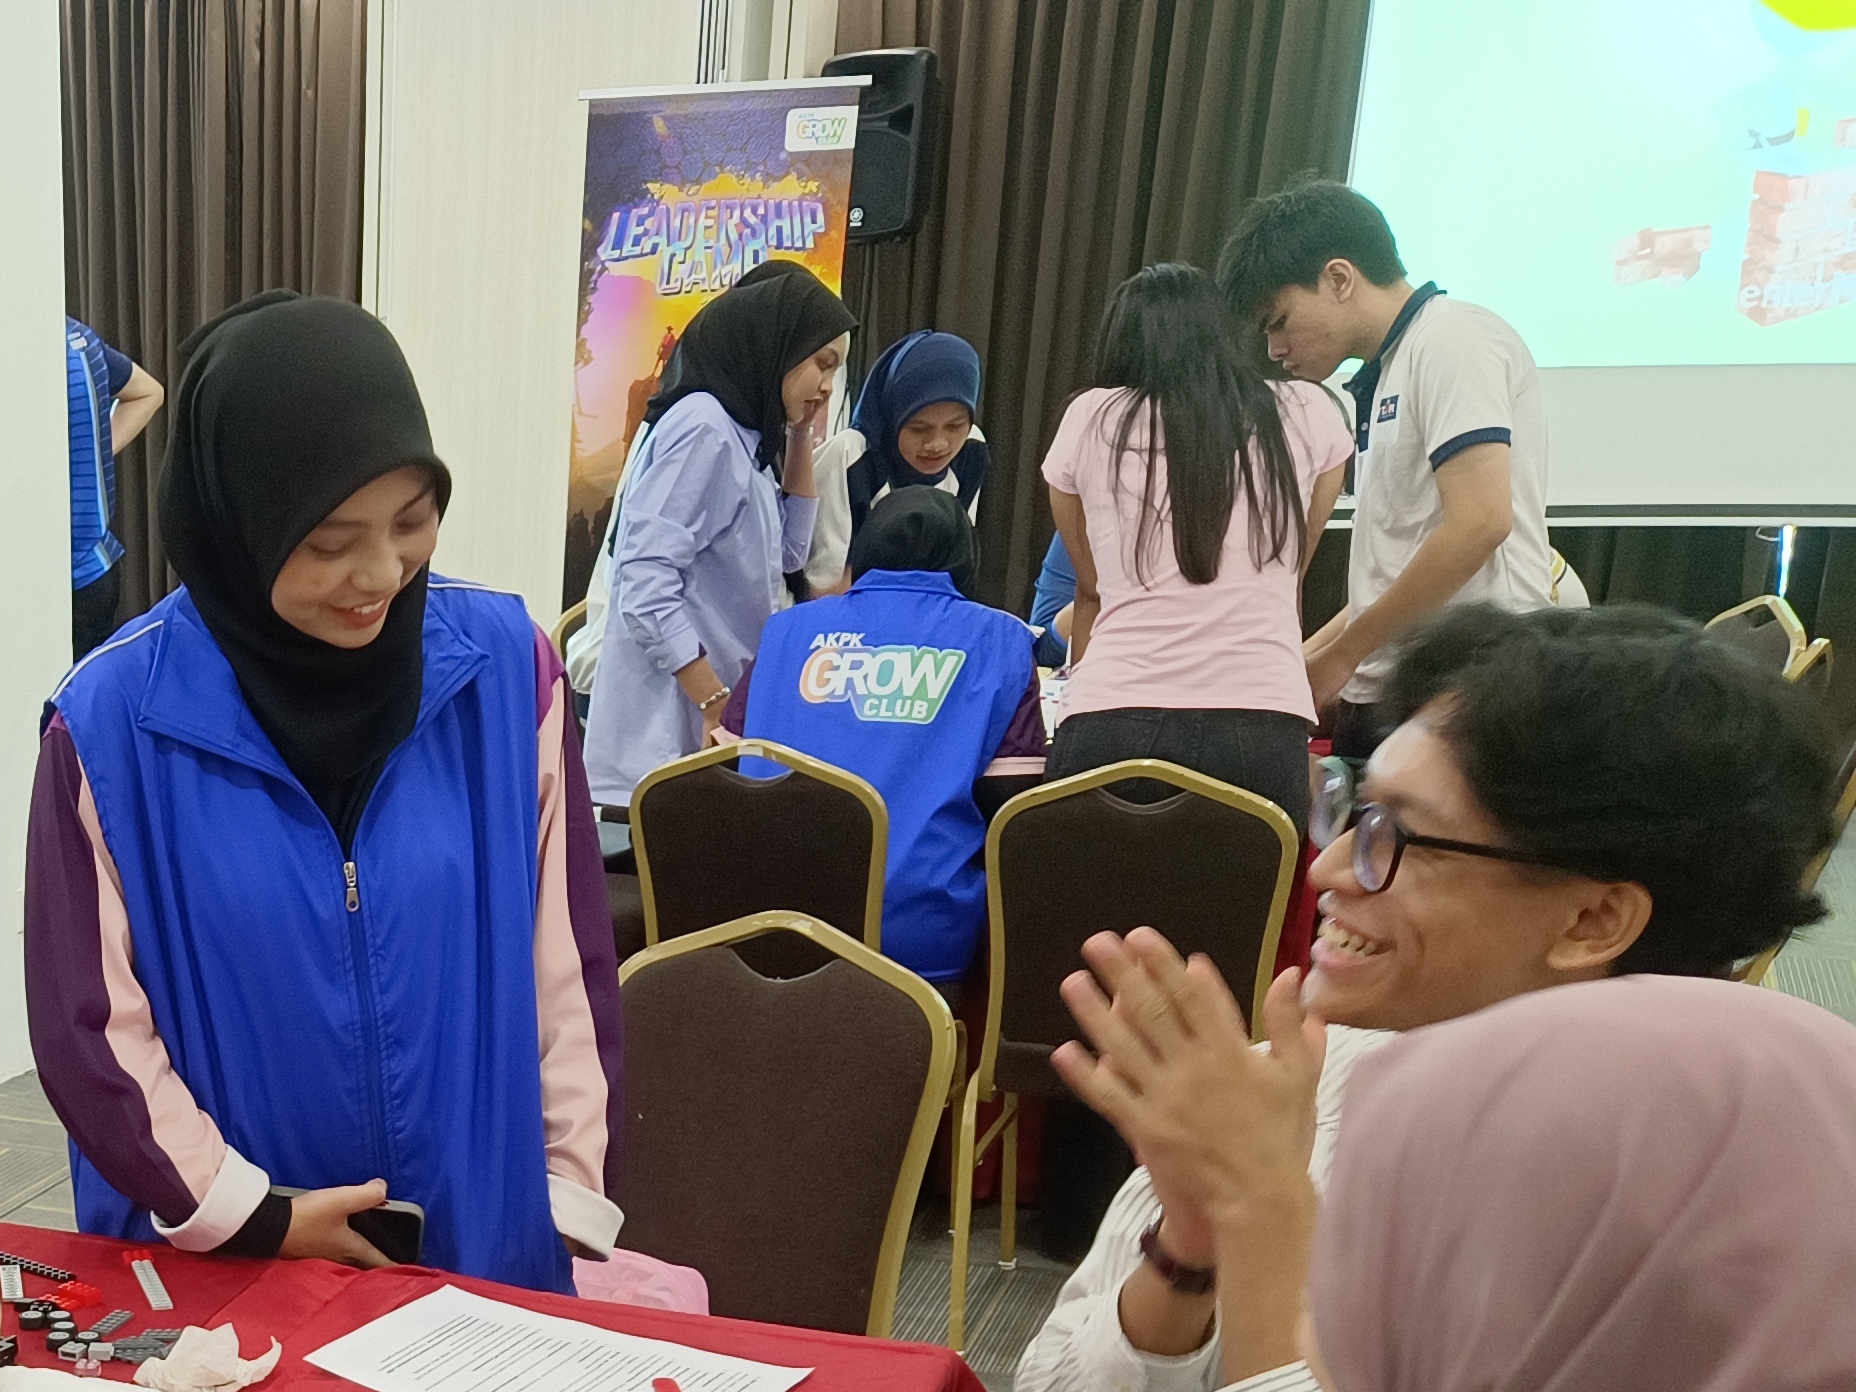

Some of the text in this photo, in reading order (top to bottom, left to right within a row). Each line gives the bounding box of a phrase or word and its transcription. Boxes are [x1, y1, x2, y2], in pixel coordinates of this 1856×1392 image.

[599, 198, 826, 262] LEADERSHIP
[656, 240, 769, 295] CAMP
[809, 632, 866, 649] AKPK
[805, 650, 960, 699] GROW
[863, 698, 929, 718] CLUB
